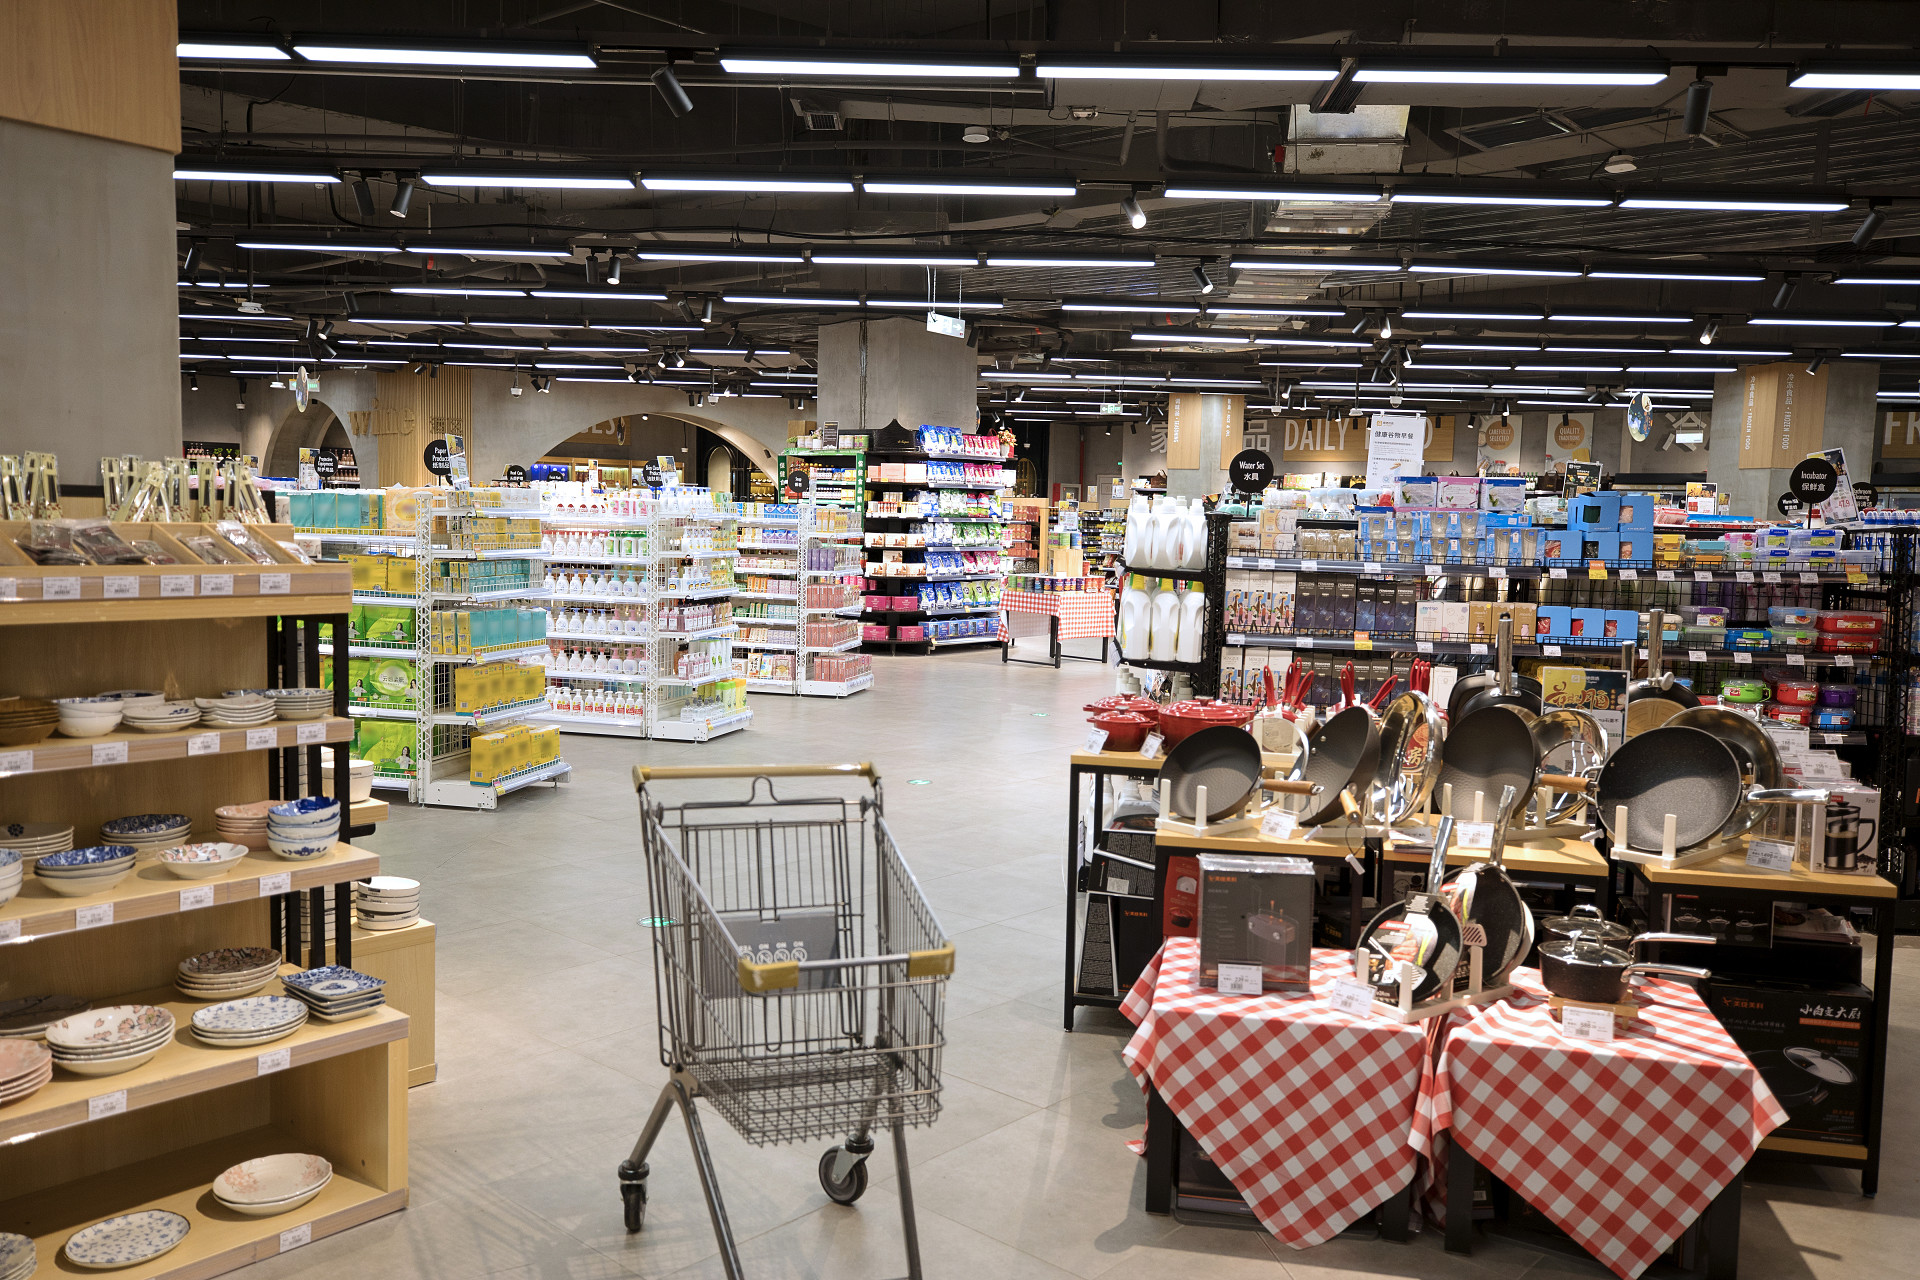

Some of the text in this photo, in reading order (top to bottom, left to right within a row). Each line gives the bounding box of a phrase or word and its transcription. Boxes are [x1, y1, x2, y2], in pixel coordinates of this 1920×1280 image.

[1284, 418, 1350, 450] DAILY
[1239, 461, 1265, 469] Water Set
[1244, 472, 1259, 480] 水具
[1801, 471, 1827, 480] Incubator
[1802, 483, 1825, 491] 保鲜盒
[1800, 1004, 1862, 1020] 小白变大厨
